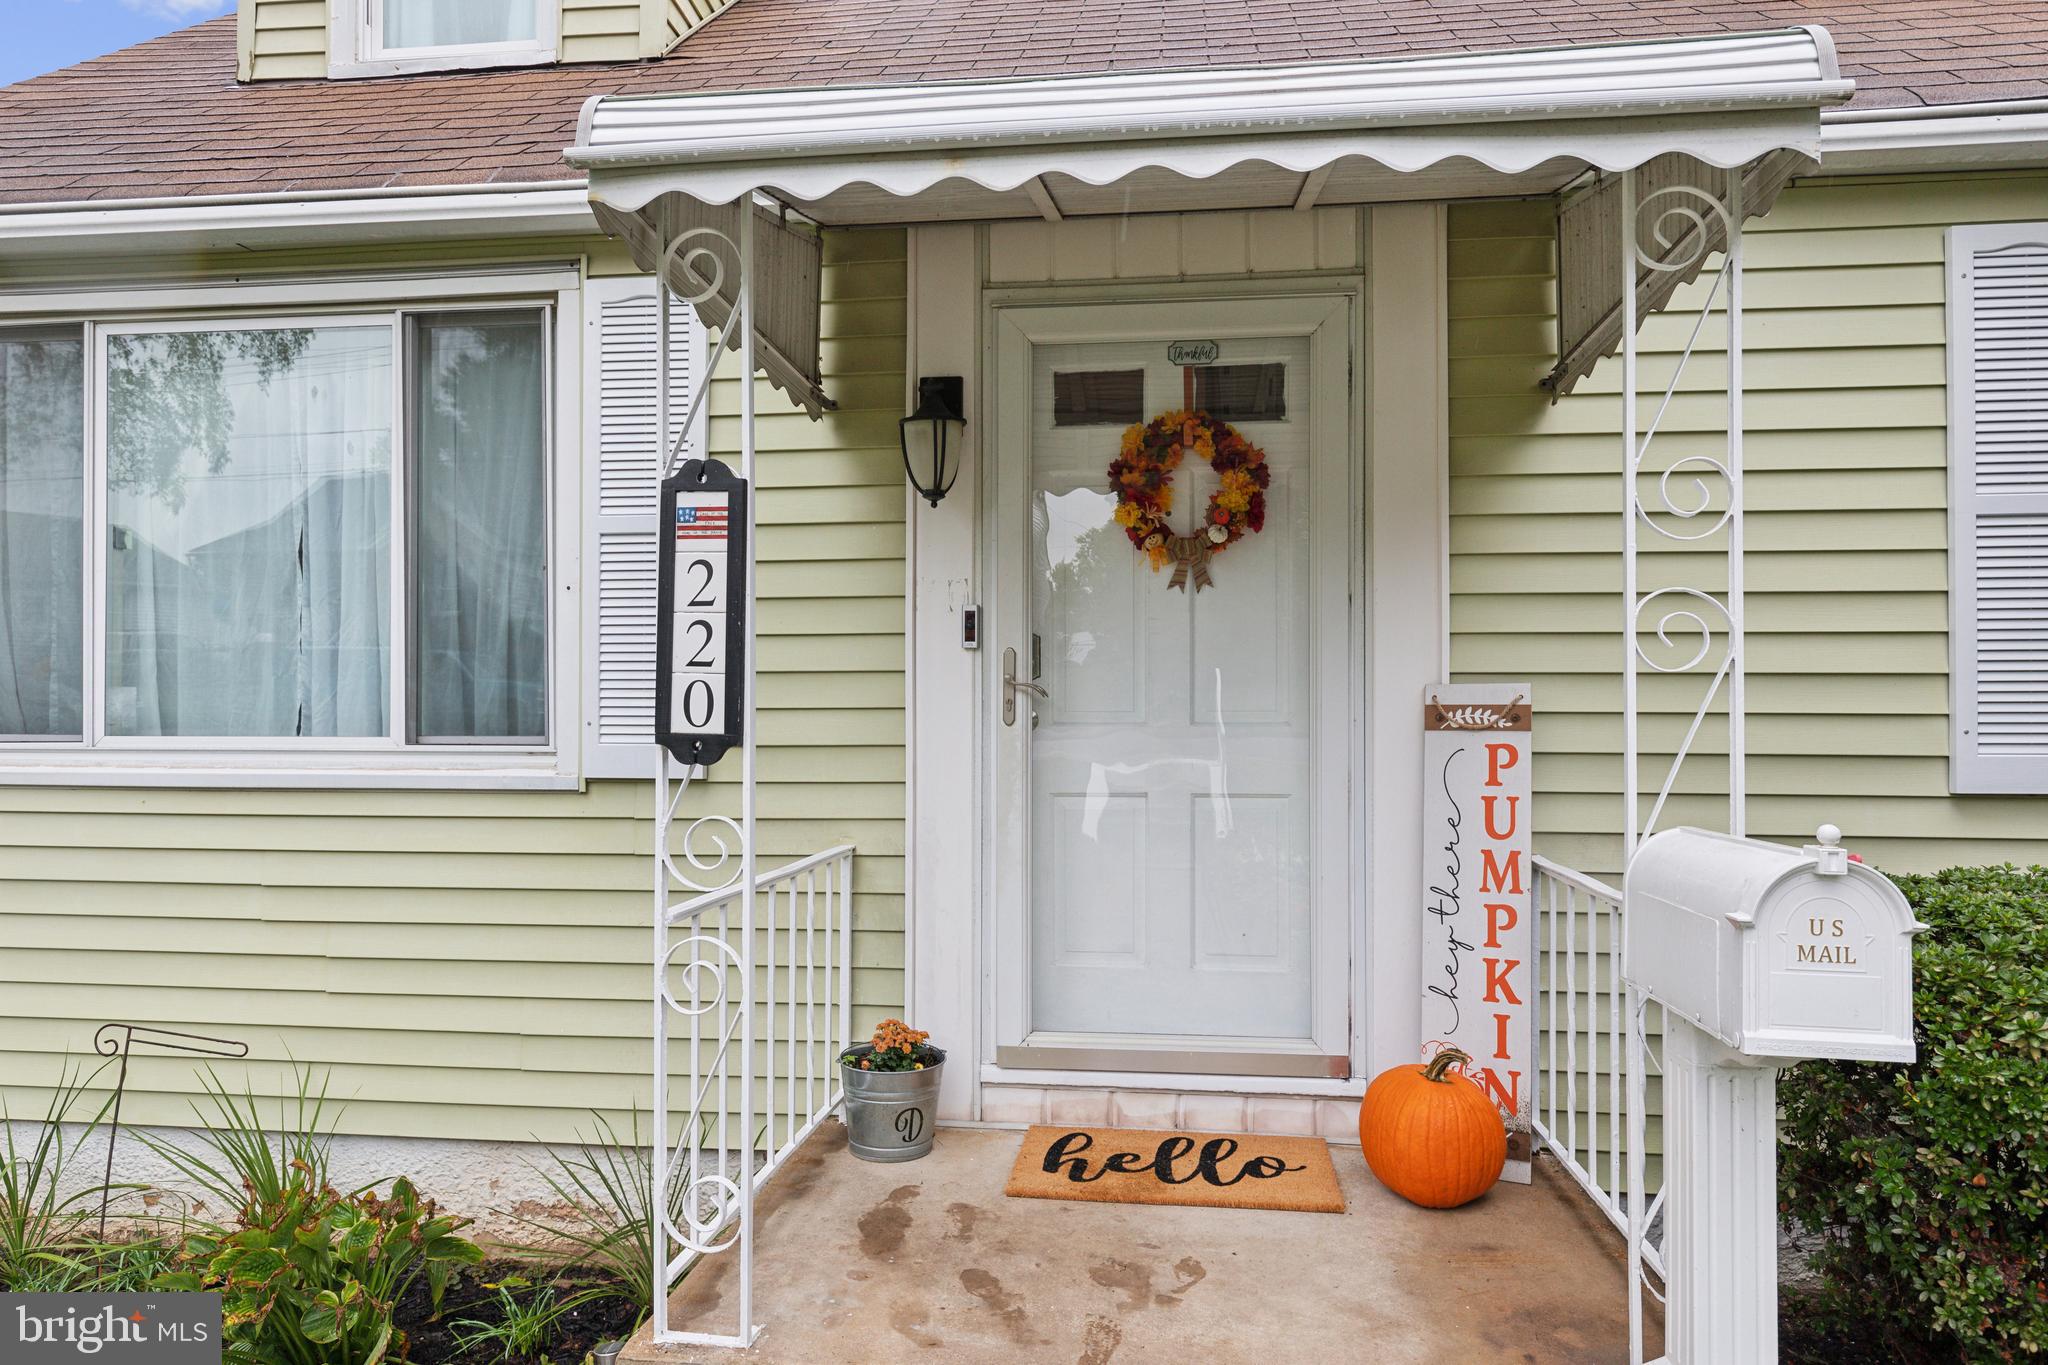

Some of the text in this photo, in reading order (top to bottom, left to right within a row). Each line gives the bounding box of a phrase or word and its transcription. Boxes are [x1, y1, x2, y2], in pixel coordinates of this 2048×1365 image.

[1172, 344, 1215, 361] Thankful
[682, 558, 717, 729] 220
[1427, 748, 1475, 1035] hey there
[1478, 742, 1524, 1118] PUMPKIN
[1796, 944, 1857, 965] MAIL
[894, 1107, 924, 1143] D
[1041, 1131, 1308, 1187] hello
